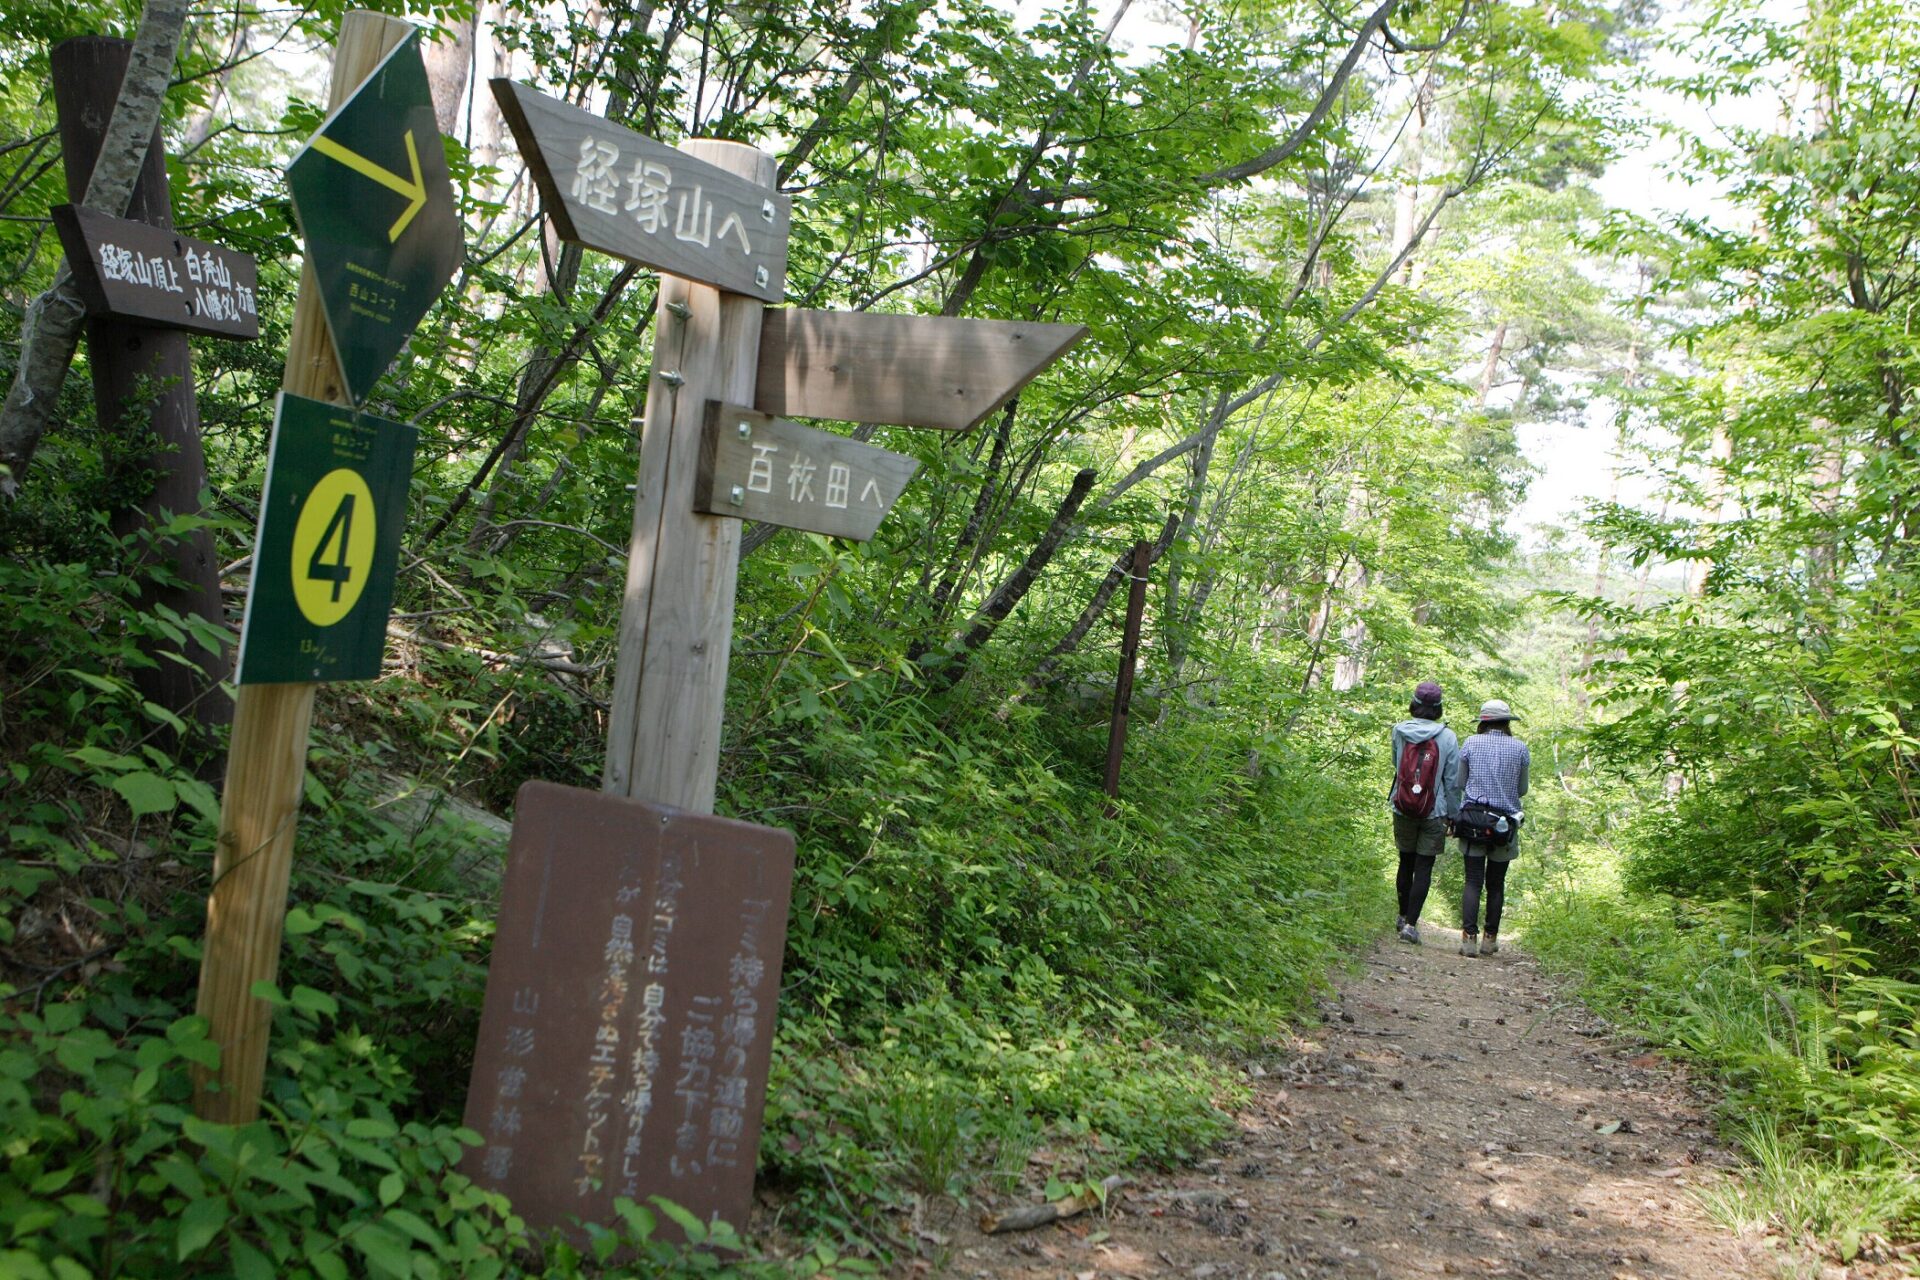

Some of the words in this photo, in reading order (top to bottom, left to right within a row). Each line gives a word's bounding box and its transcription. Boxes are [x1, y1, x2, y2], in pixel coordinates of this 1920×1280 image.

[571, 135, 751, 256] 経塚山へ
[746, 441, 884, 509] 百枚田へ
[306, 493, 357, 603] 4
